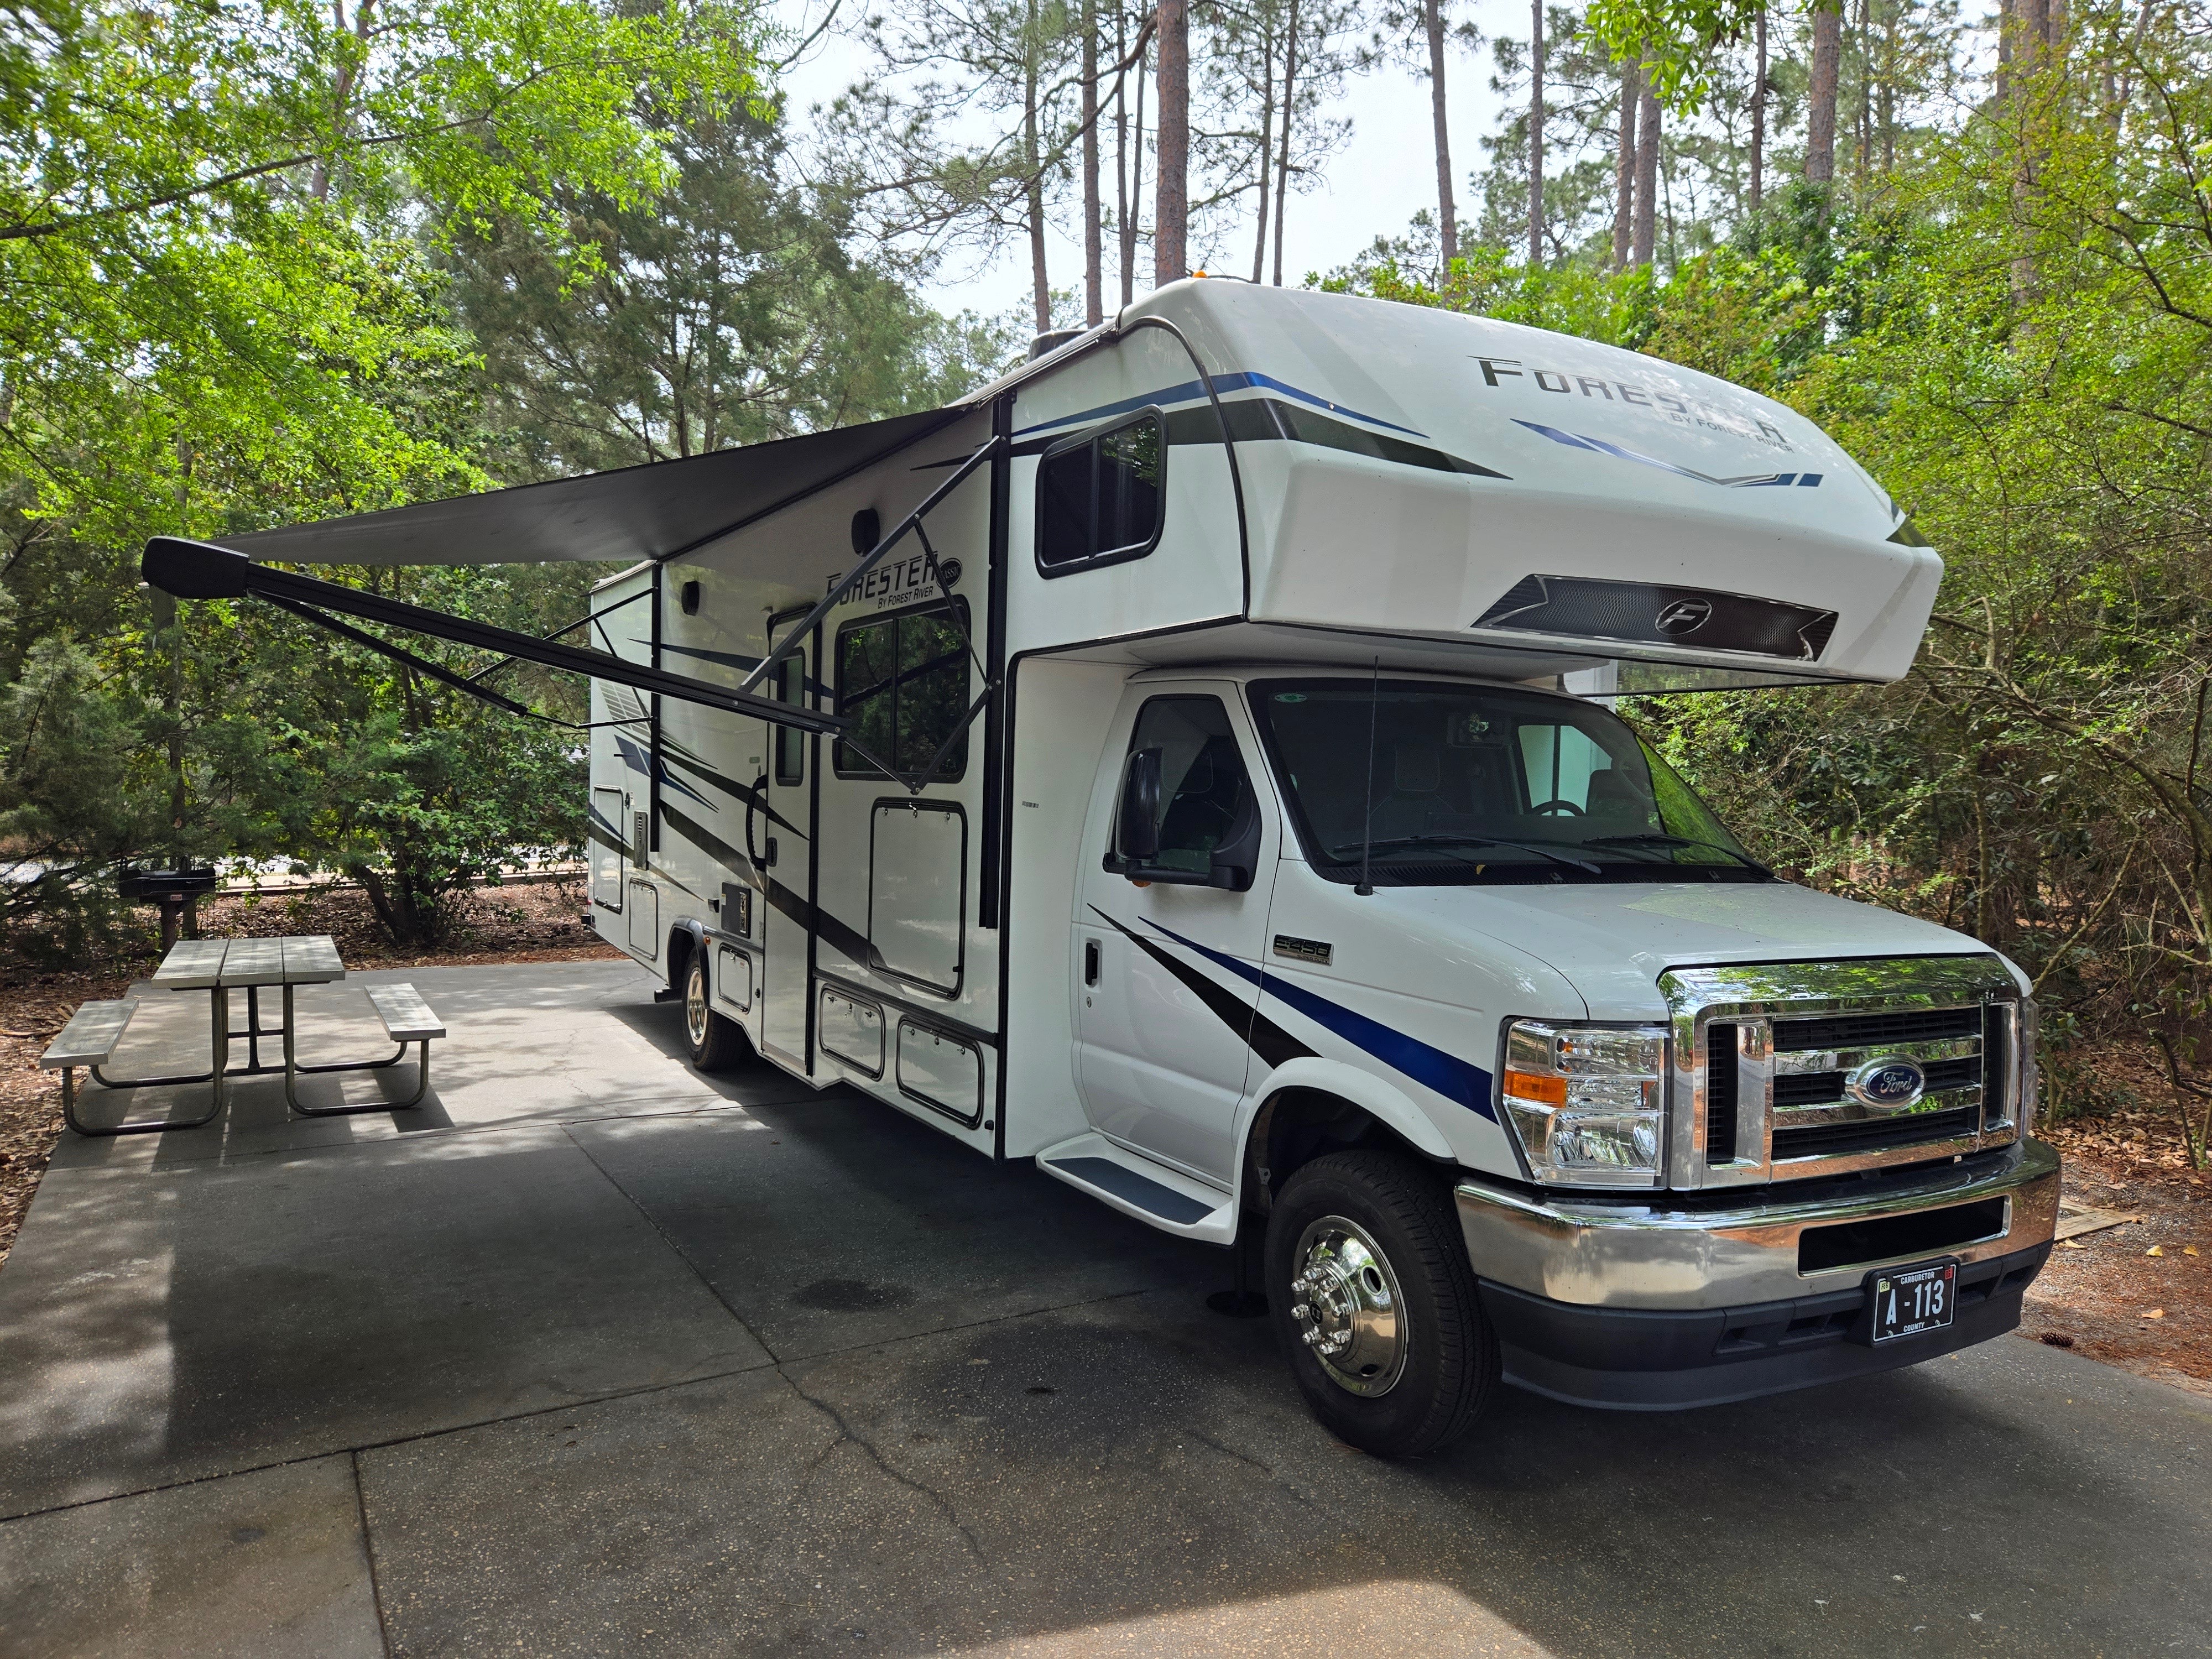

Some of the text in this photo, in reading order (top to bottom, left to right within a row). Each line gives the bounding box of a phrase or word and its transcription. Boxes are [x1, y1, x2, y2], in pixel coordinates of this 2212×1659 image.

[1669, 412, 1796, 454] BY FOREST RIVER
[878, 586, 934, 609] BY FOREST RIVER
[1880, 1071, 1913, 1094] Ford
[1900, 1271, 1935, 1285] CARBURETOR
[1903, 1322, 1926, 1333] COUNTY
